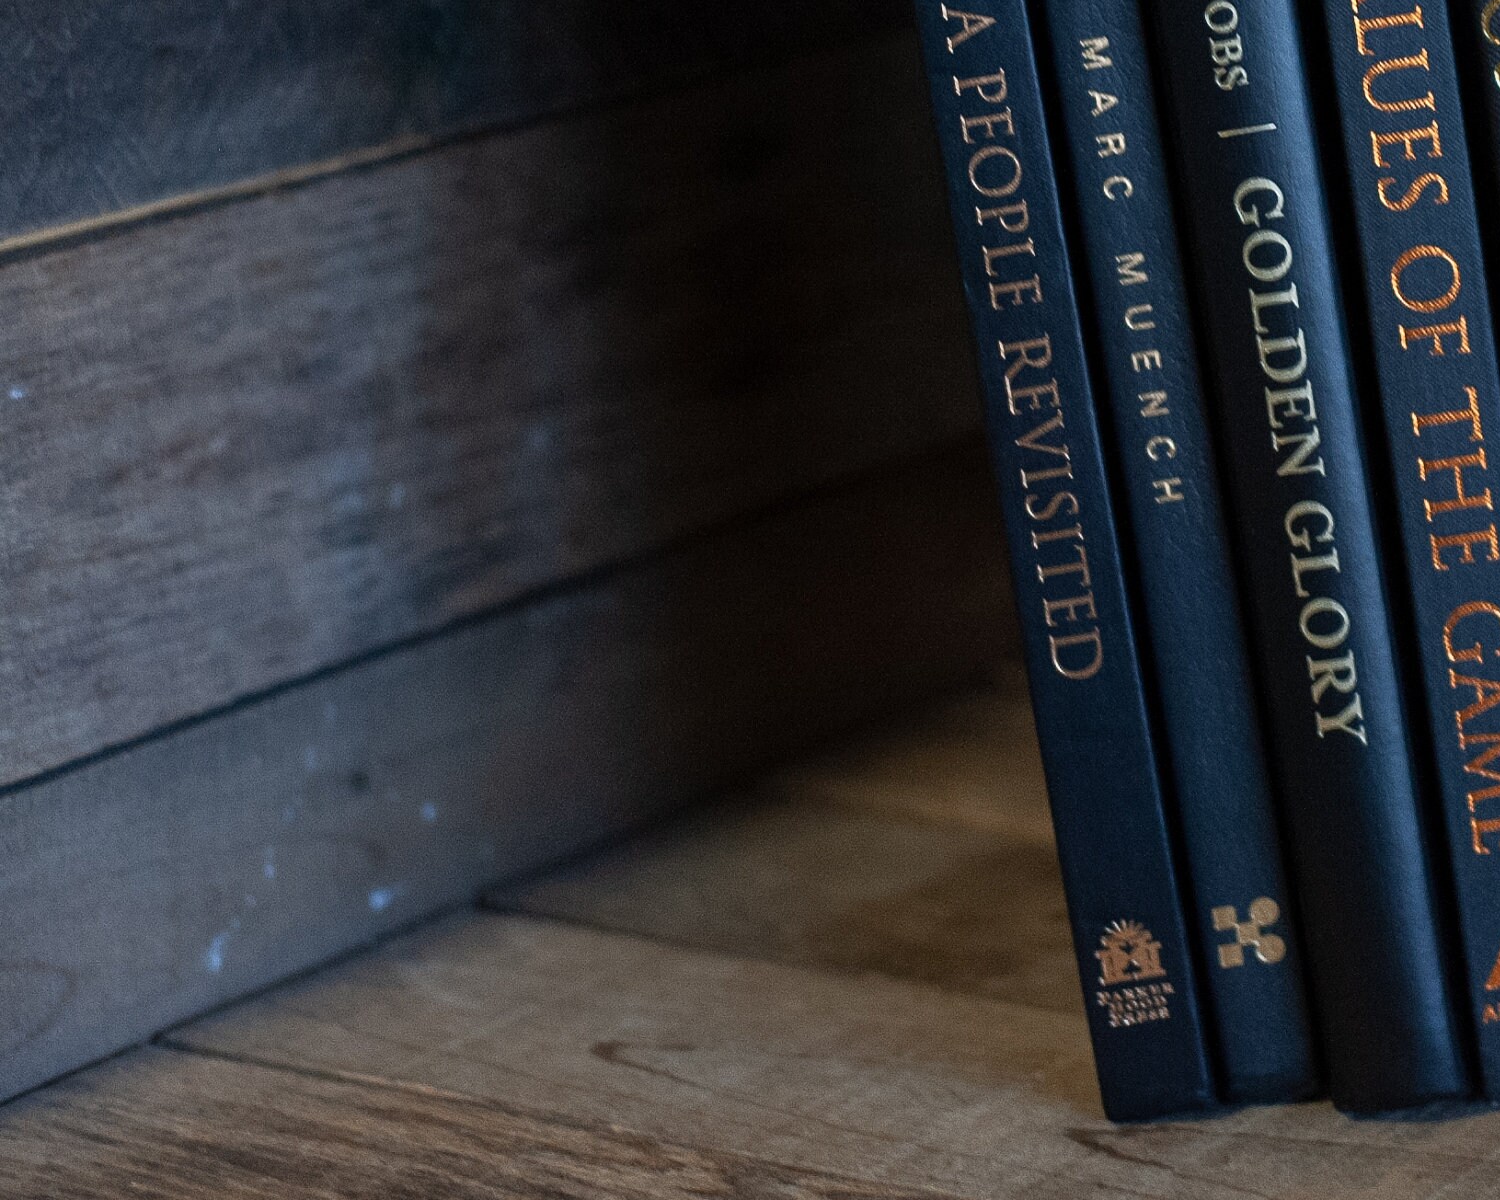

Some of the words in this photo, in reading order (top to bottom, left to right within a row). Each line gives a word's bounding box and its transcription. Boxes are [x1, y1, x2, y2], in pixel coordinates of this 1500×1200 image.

[940, 1, 999, 55] A
[952, 66, 1046, 312] PEOPLE
[1079, 35, 1136, 202] MARC
[1114, 250, 1186, 505] MUENCH
[1390, 243, 1473, 357] OF
[997, 330, 1105, 682] REVISITED
[1232, 175, 1328, 479] GOLDEN
[1283, 499, 1370, 747] GLORY
